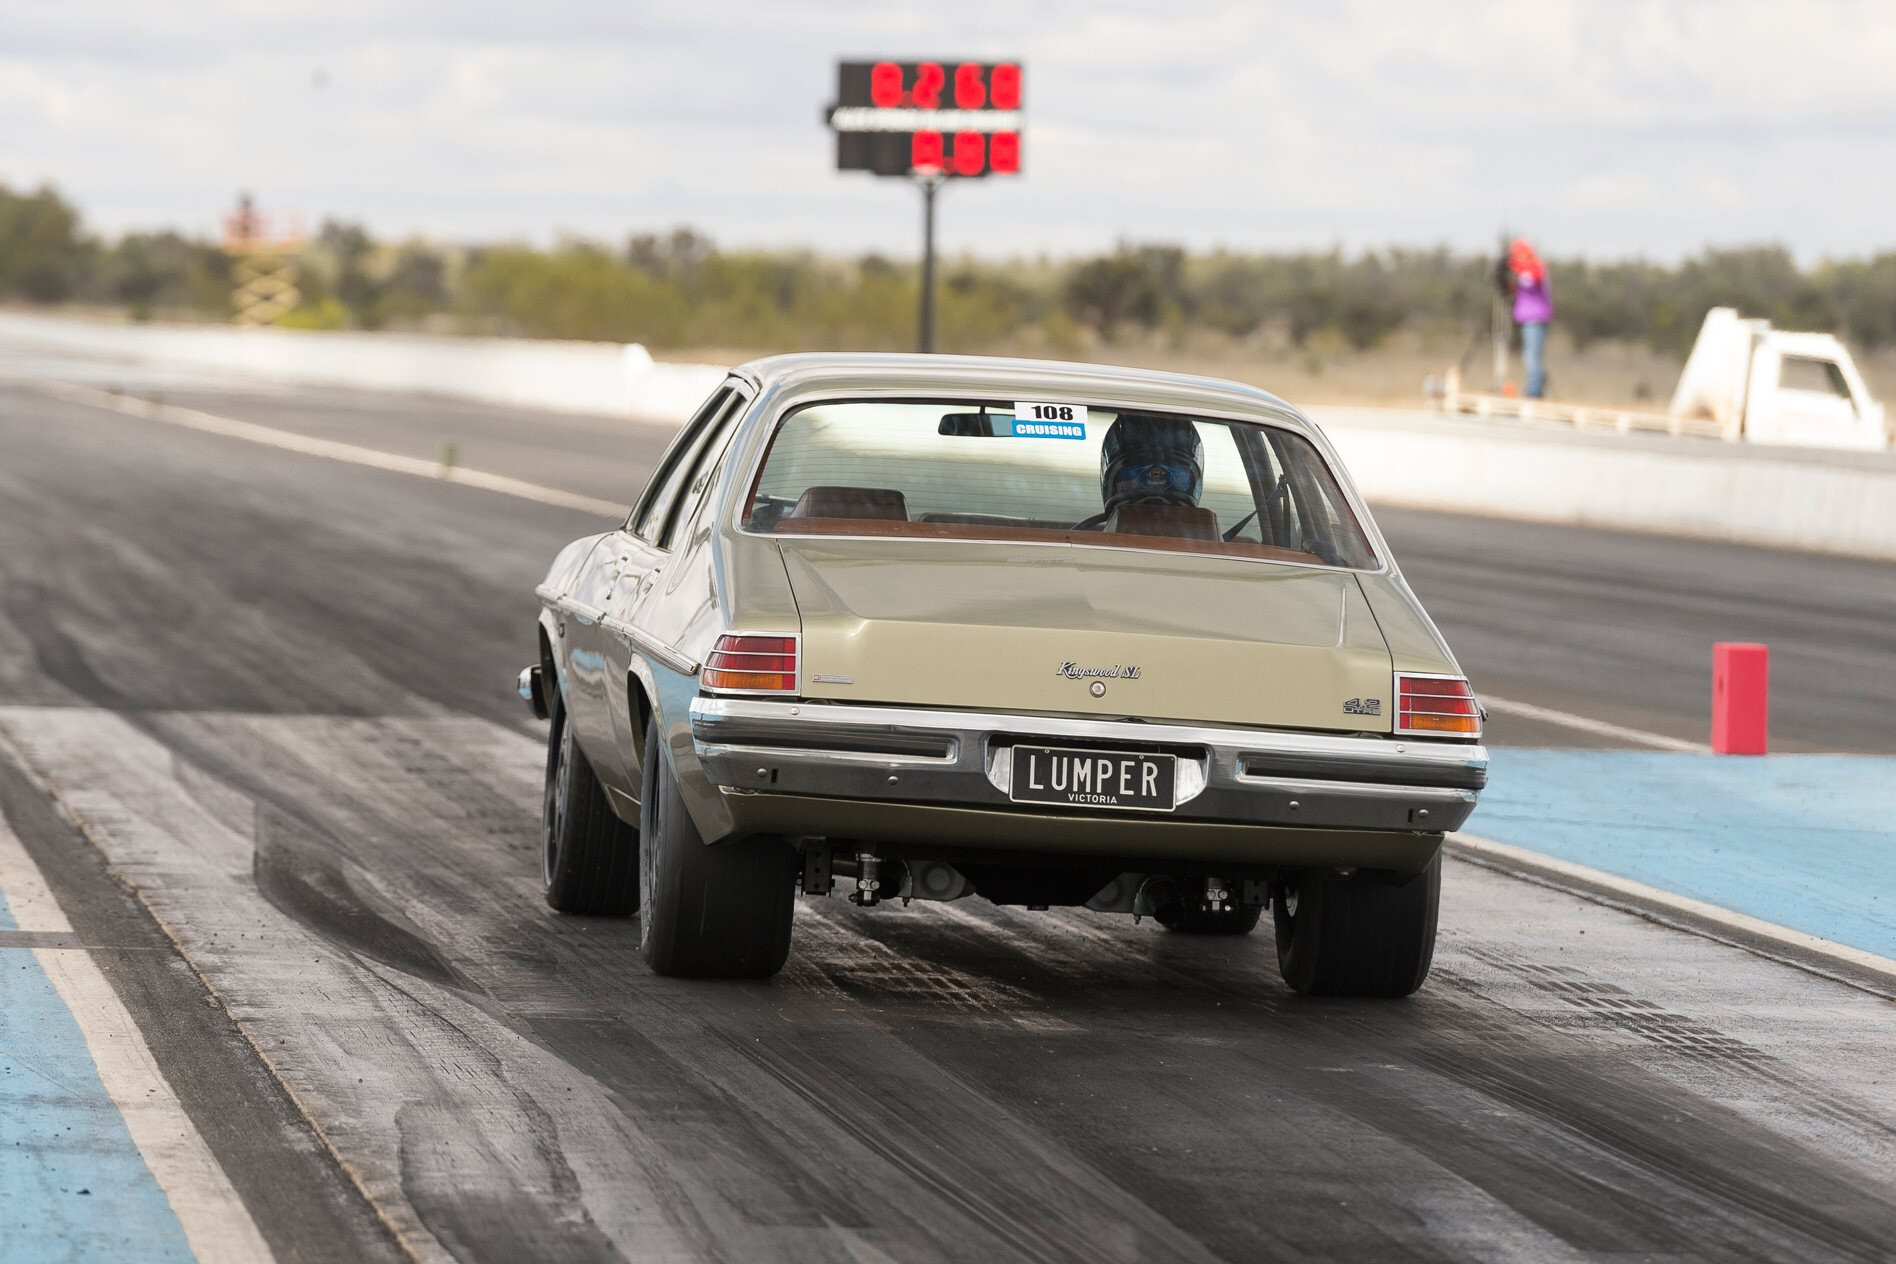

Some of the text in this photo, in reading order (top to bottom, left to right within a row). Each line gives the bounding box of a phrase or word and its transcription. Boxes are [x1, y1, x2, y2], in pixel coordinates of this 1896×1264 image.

[1031, 405, 1073, 421] 108
[1016, 424, 1082, 437] CRUISING
[1056, 661, 1141, 679] Kingswood SL
[1029, 755, 1158, 797] LUMPER
[1068, 793, 1117, 804] VICTORIA
